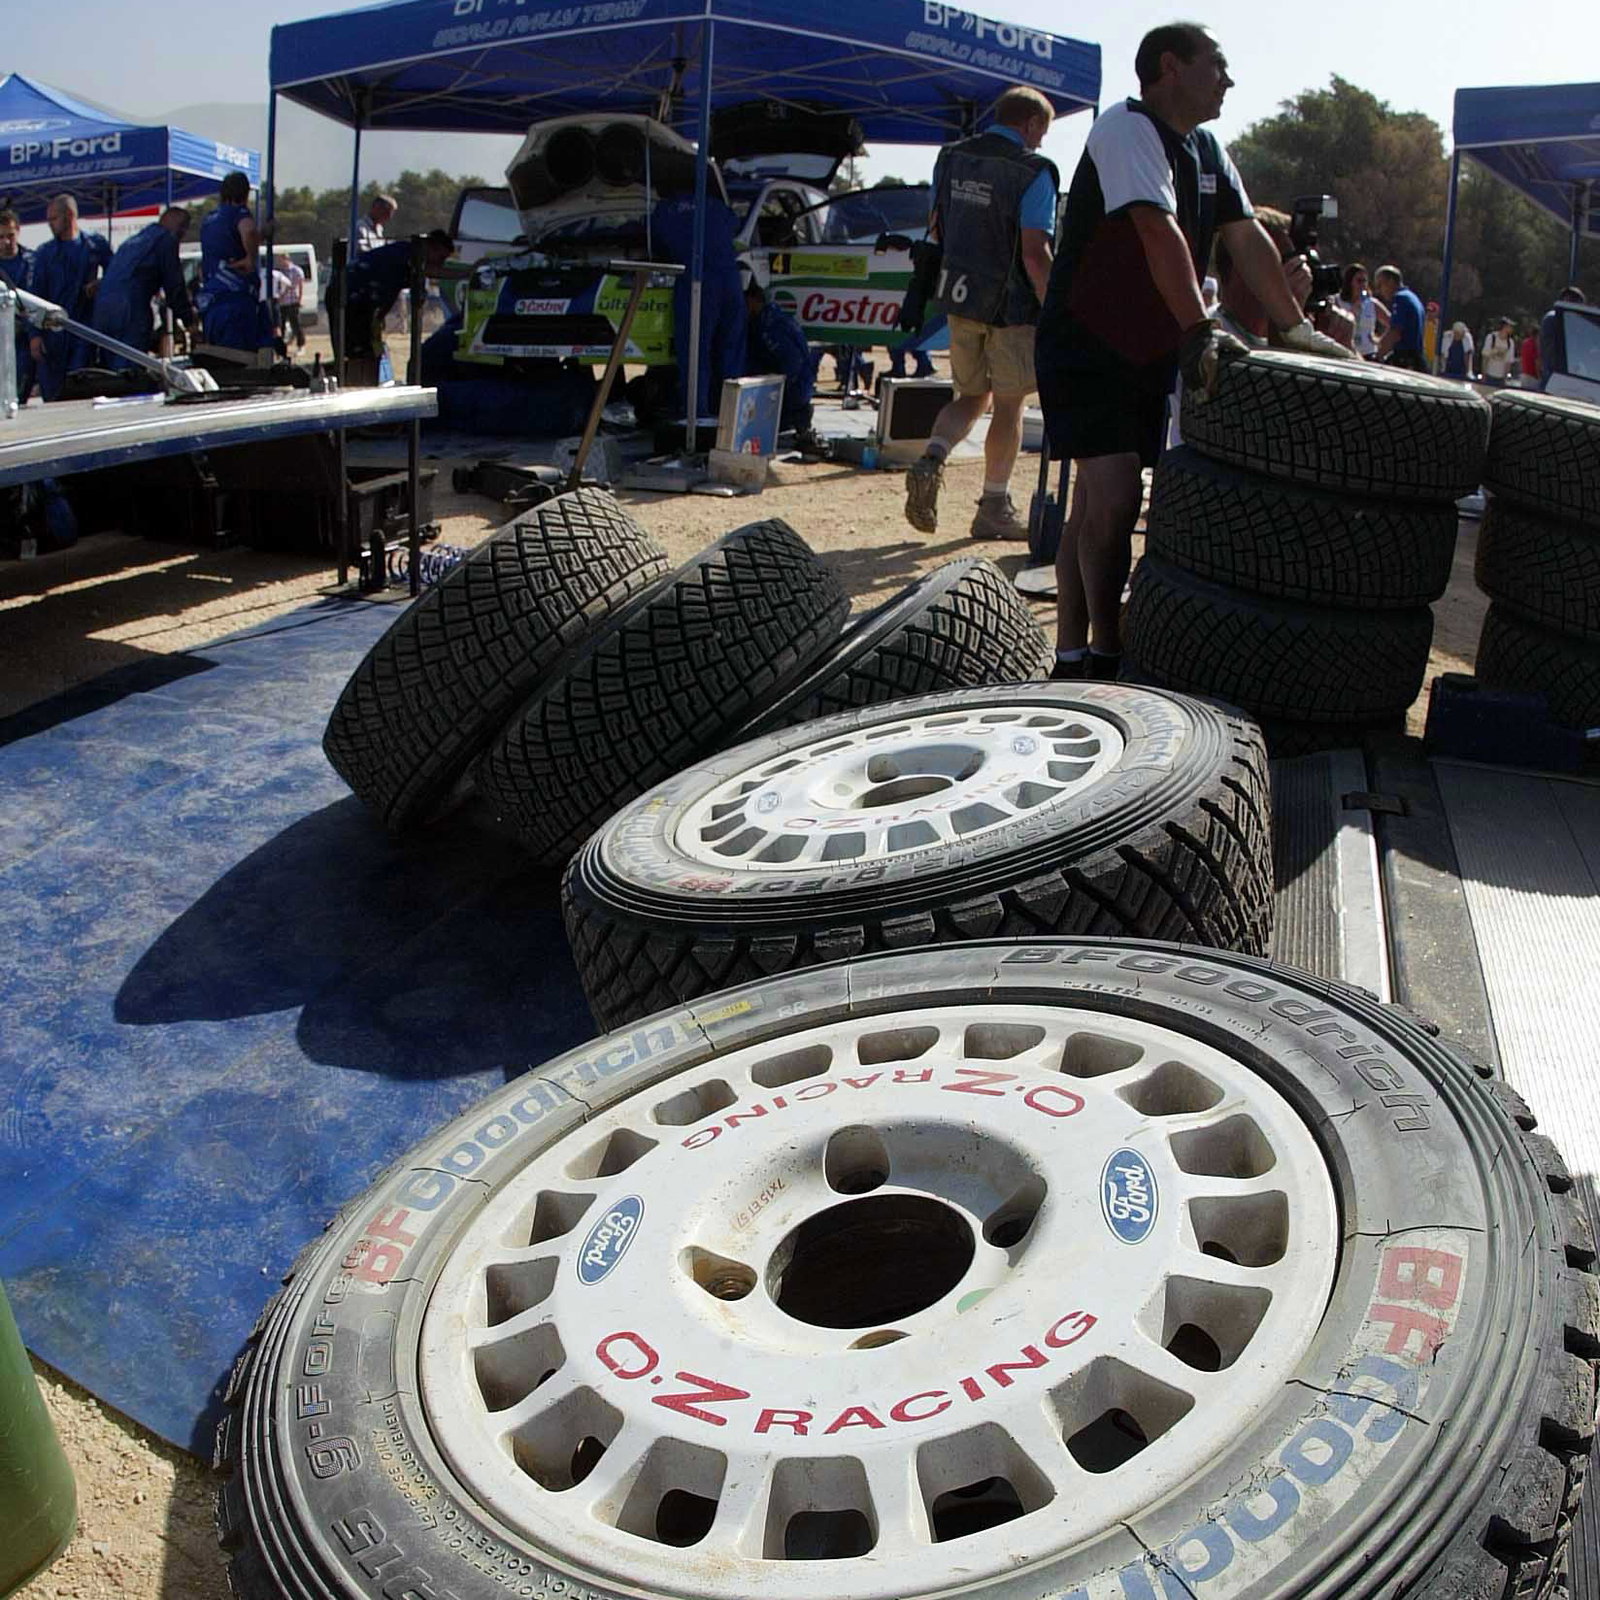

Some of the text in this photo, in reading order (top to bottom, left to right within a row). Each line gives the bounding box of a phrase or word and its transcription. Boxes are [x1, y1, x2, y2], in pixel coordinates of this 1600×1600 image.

[772, 254, 785, 273] 4
[937, 269, 969, 303] 16
[801, 293, 901, 325] Castro
[1000, 946, 1430, 1132] BFGoodrich
[680, 1067, 1087, 1150] O.Z RACING
[352, 1022, 679, 1285] BFGoodrich
[1107, 1163, 1151, 1223] Ford
[583, 1211, 637, 1268] Ford
[595, 1310, 1099, 1437] O.Z RACING
[371, 1429, 394, 1462] ONLY
[382, 1401, 440, 1500] EXCLUSIVEMENT
[1060, 1246, 1464, 1600] BFGood
[387, 1465, 431, 1524] PURPOSE
[437, 1501, 534, 1577] COMPETITION
